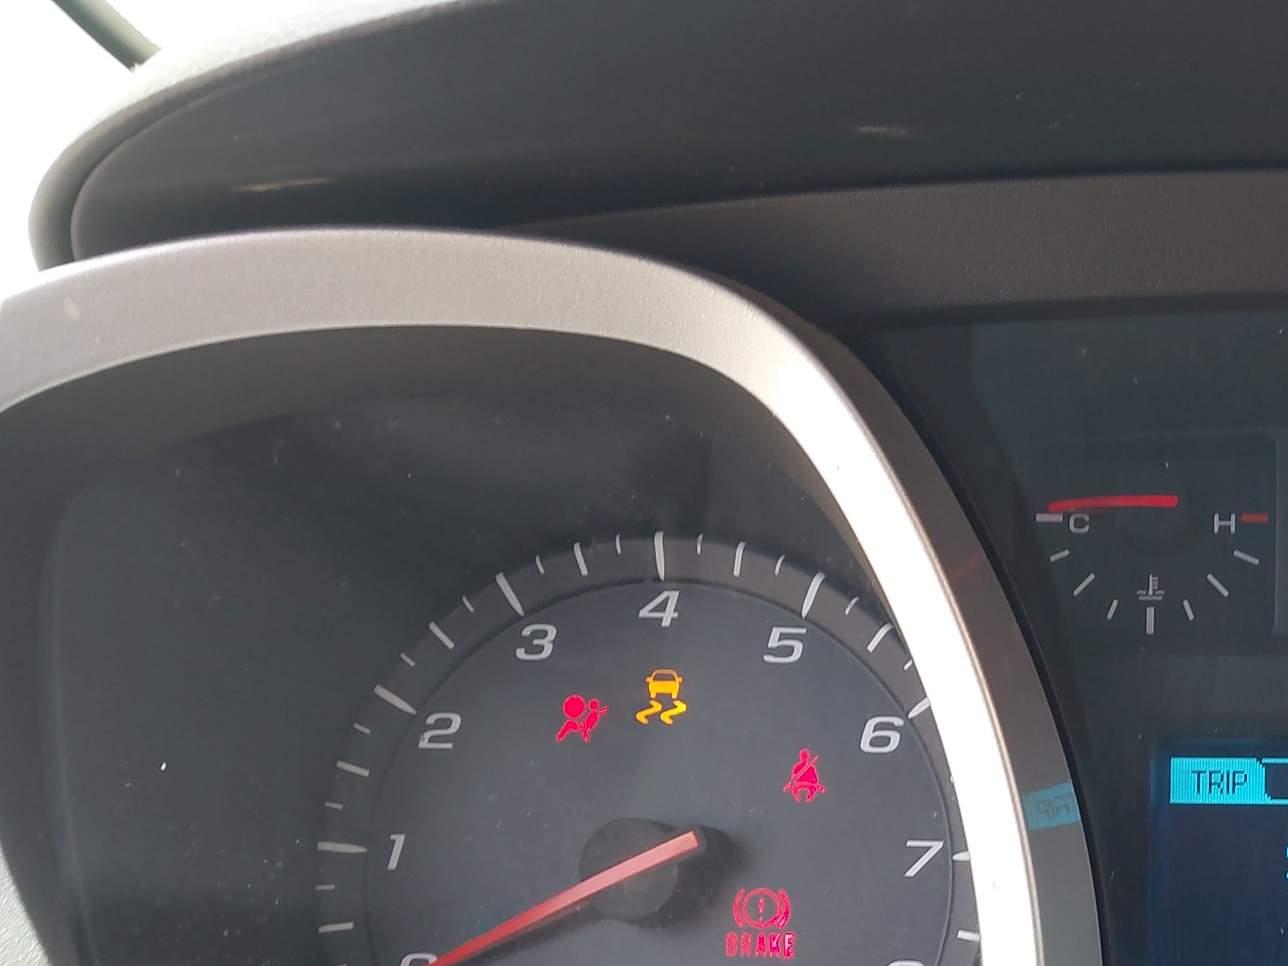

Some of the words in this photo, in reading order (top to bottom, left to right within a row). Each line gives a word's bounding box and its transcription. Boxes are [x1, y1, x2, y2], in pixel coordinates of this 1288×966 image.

[1068, 513, 1090, 533] C
[1212, 513, 1236, 533] H
[638, 590, 680, 627] 4
[515, 624, 557, 661] 3
[763, 626, 807, 664] 5
[418, 712, 461, 749] 2
[860, 715, 904, 754] 6
[1191, 770, 1249, 795] TRIP
[387, 834, 405, 870] 1
[904, 839, 944, 877] 7
[725, 932, 796, 958] BRAKE
